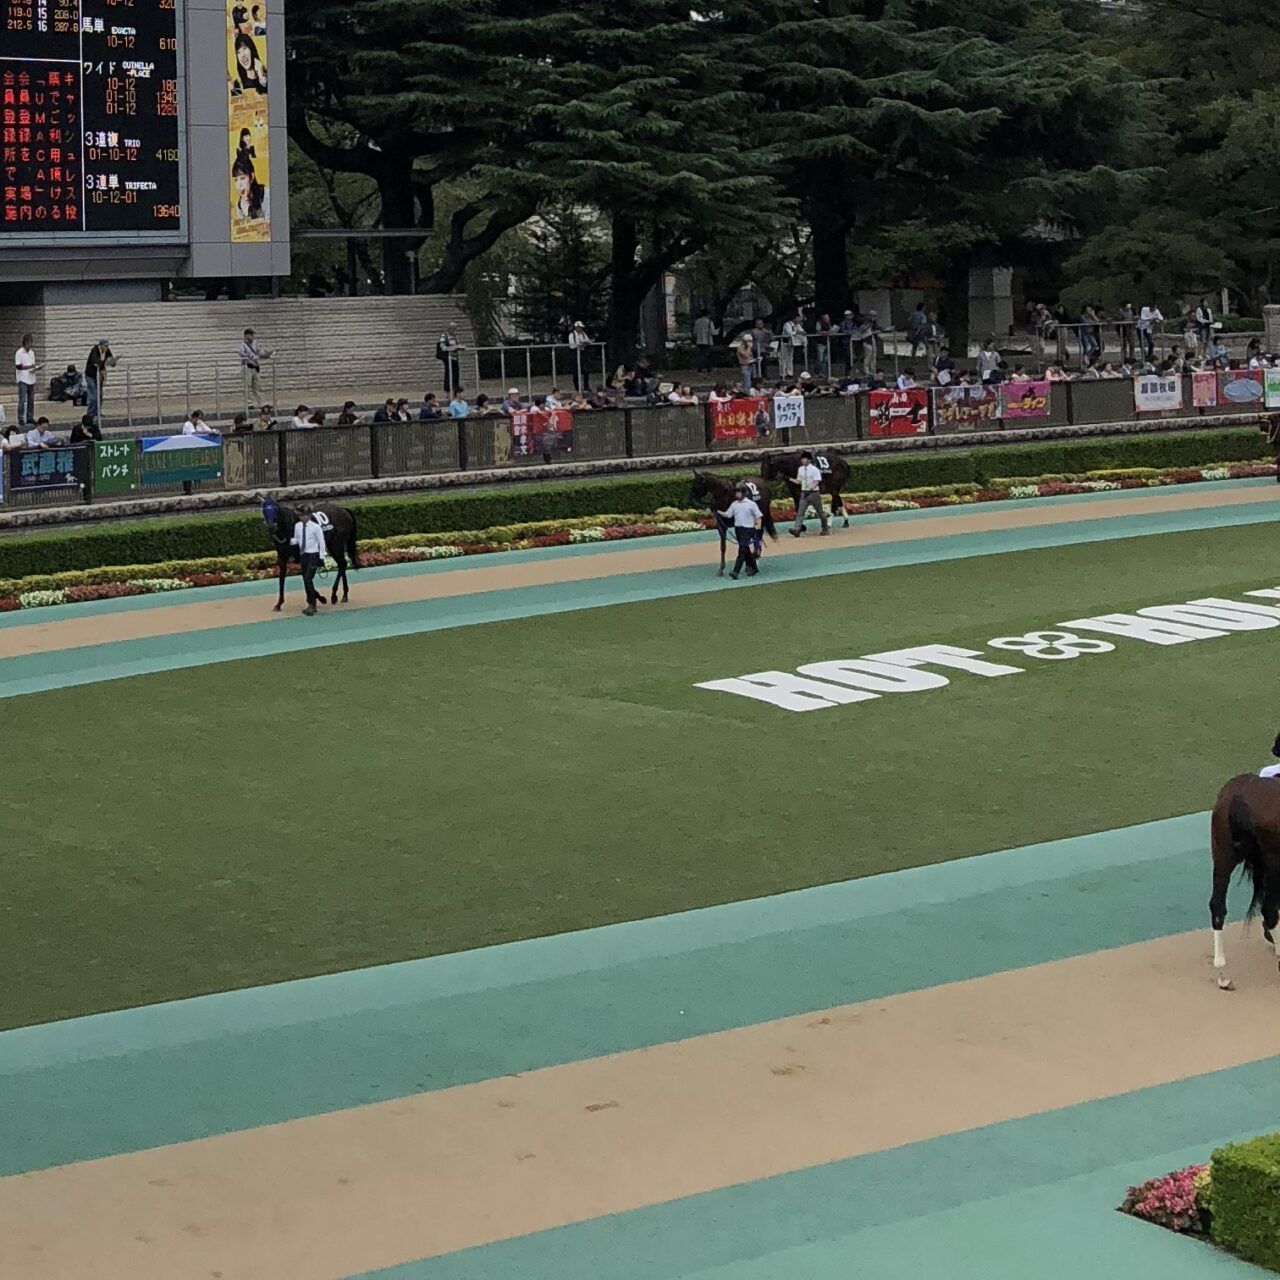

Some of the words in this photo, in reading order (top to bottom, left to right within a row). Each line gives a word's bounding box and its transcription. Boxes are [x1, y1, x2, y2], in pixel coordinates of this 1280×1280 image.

[107, 35, 134, 48] 10-12
[160, 38, 176, 49] 610
[90, 148, 137, 160] 01-10-12
[92, 191, 137, 203] 10-12-01
[817, 456, 830, 469] 13
[102, 464, 129, 478] パンチ
[312, 511, 329, 525] 10
[692, 644, 1026, 712] HOT
